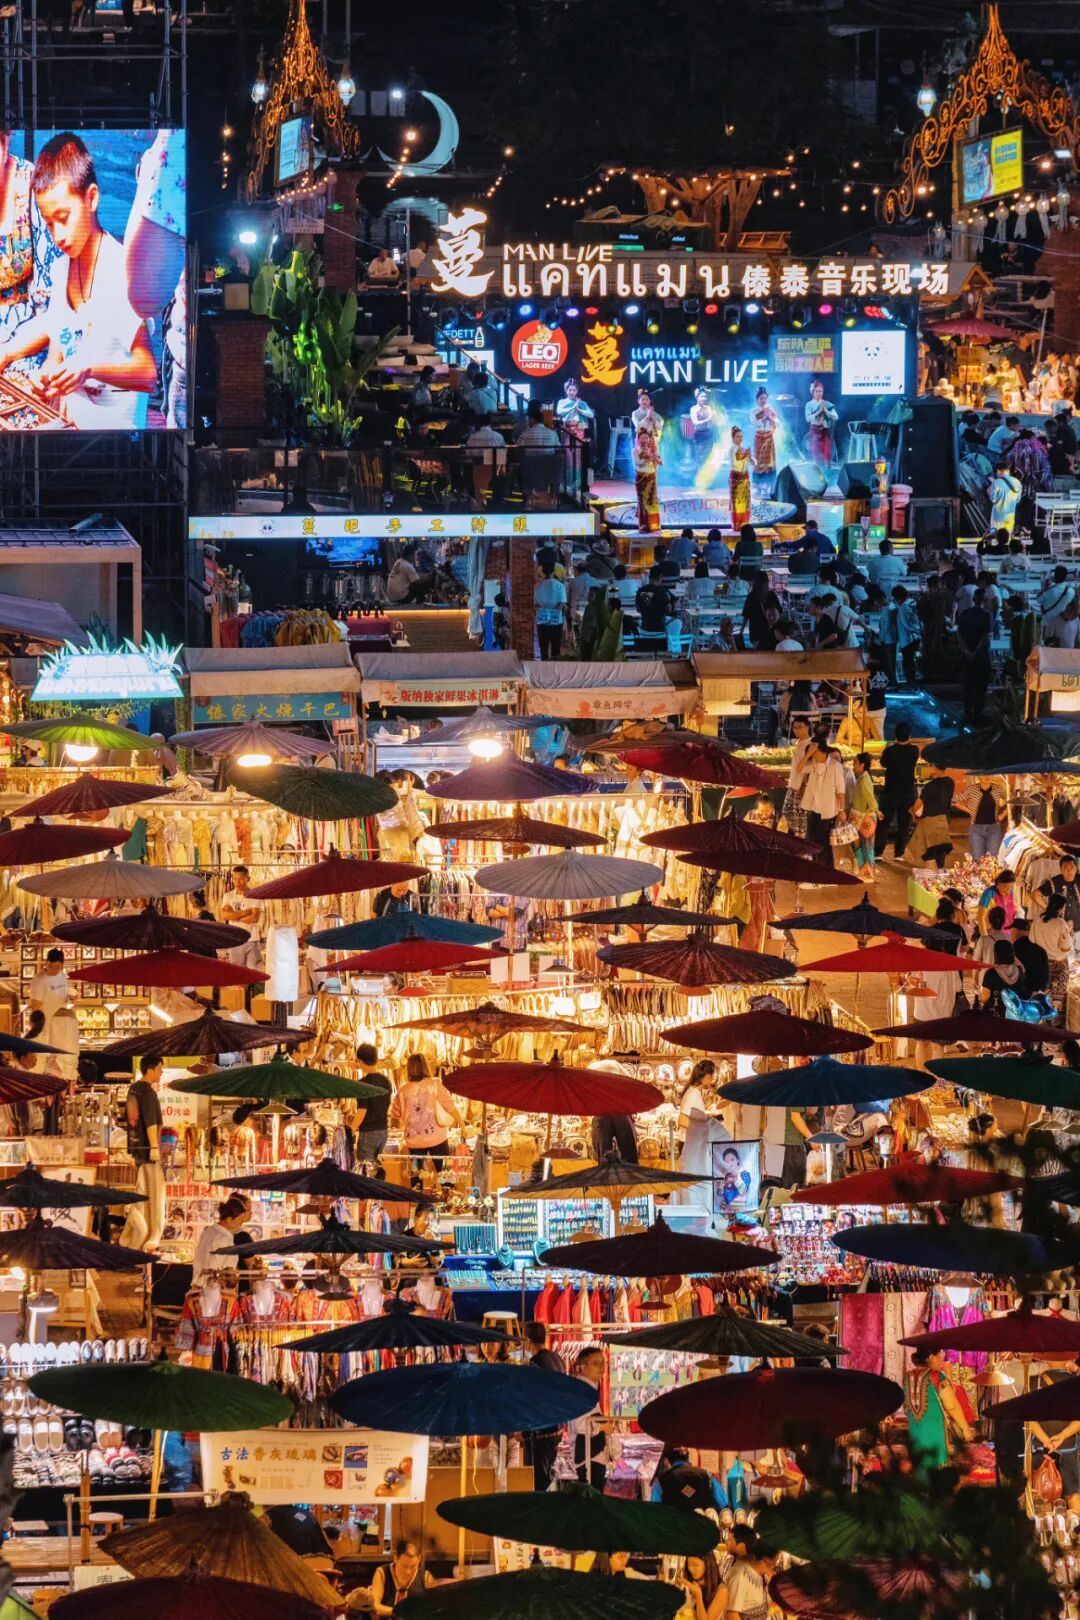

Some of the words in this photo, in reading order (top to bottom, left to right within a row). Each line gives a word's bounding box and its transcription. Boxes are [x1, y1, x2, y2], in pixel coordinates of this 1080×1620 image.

[503, 243, 554, 261] MAN
[563, 244, 613, 263] LIVE
[503, 263, 729, 298] แคทแมน
[741, 262, 949, 298] 傣泰音乐现场
[520, 344, 558, 361] LEO
[630, 360, 693, 384] MAN
[705, 360, 769, 383] LIVE
